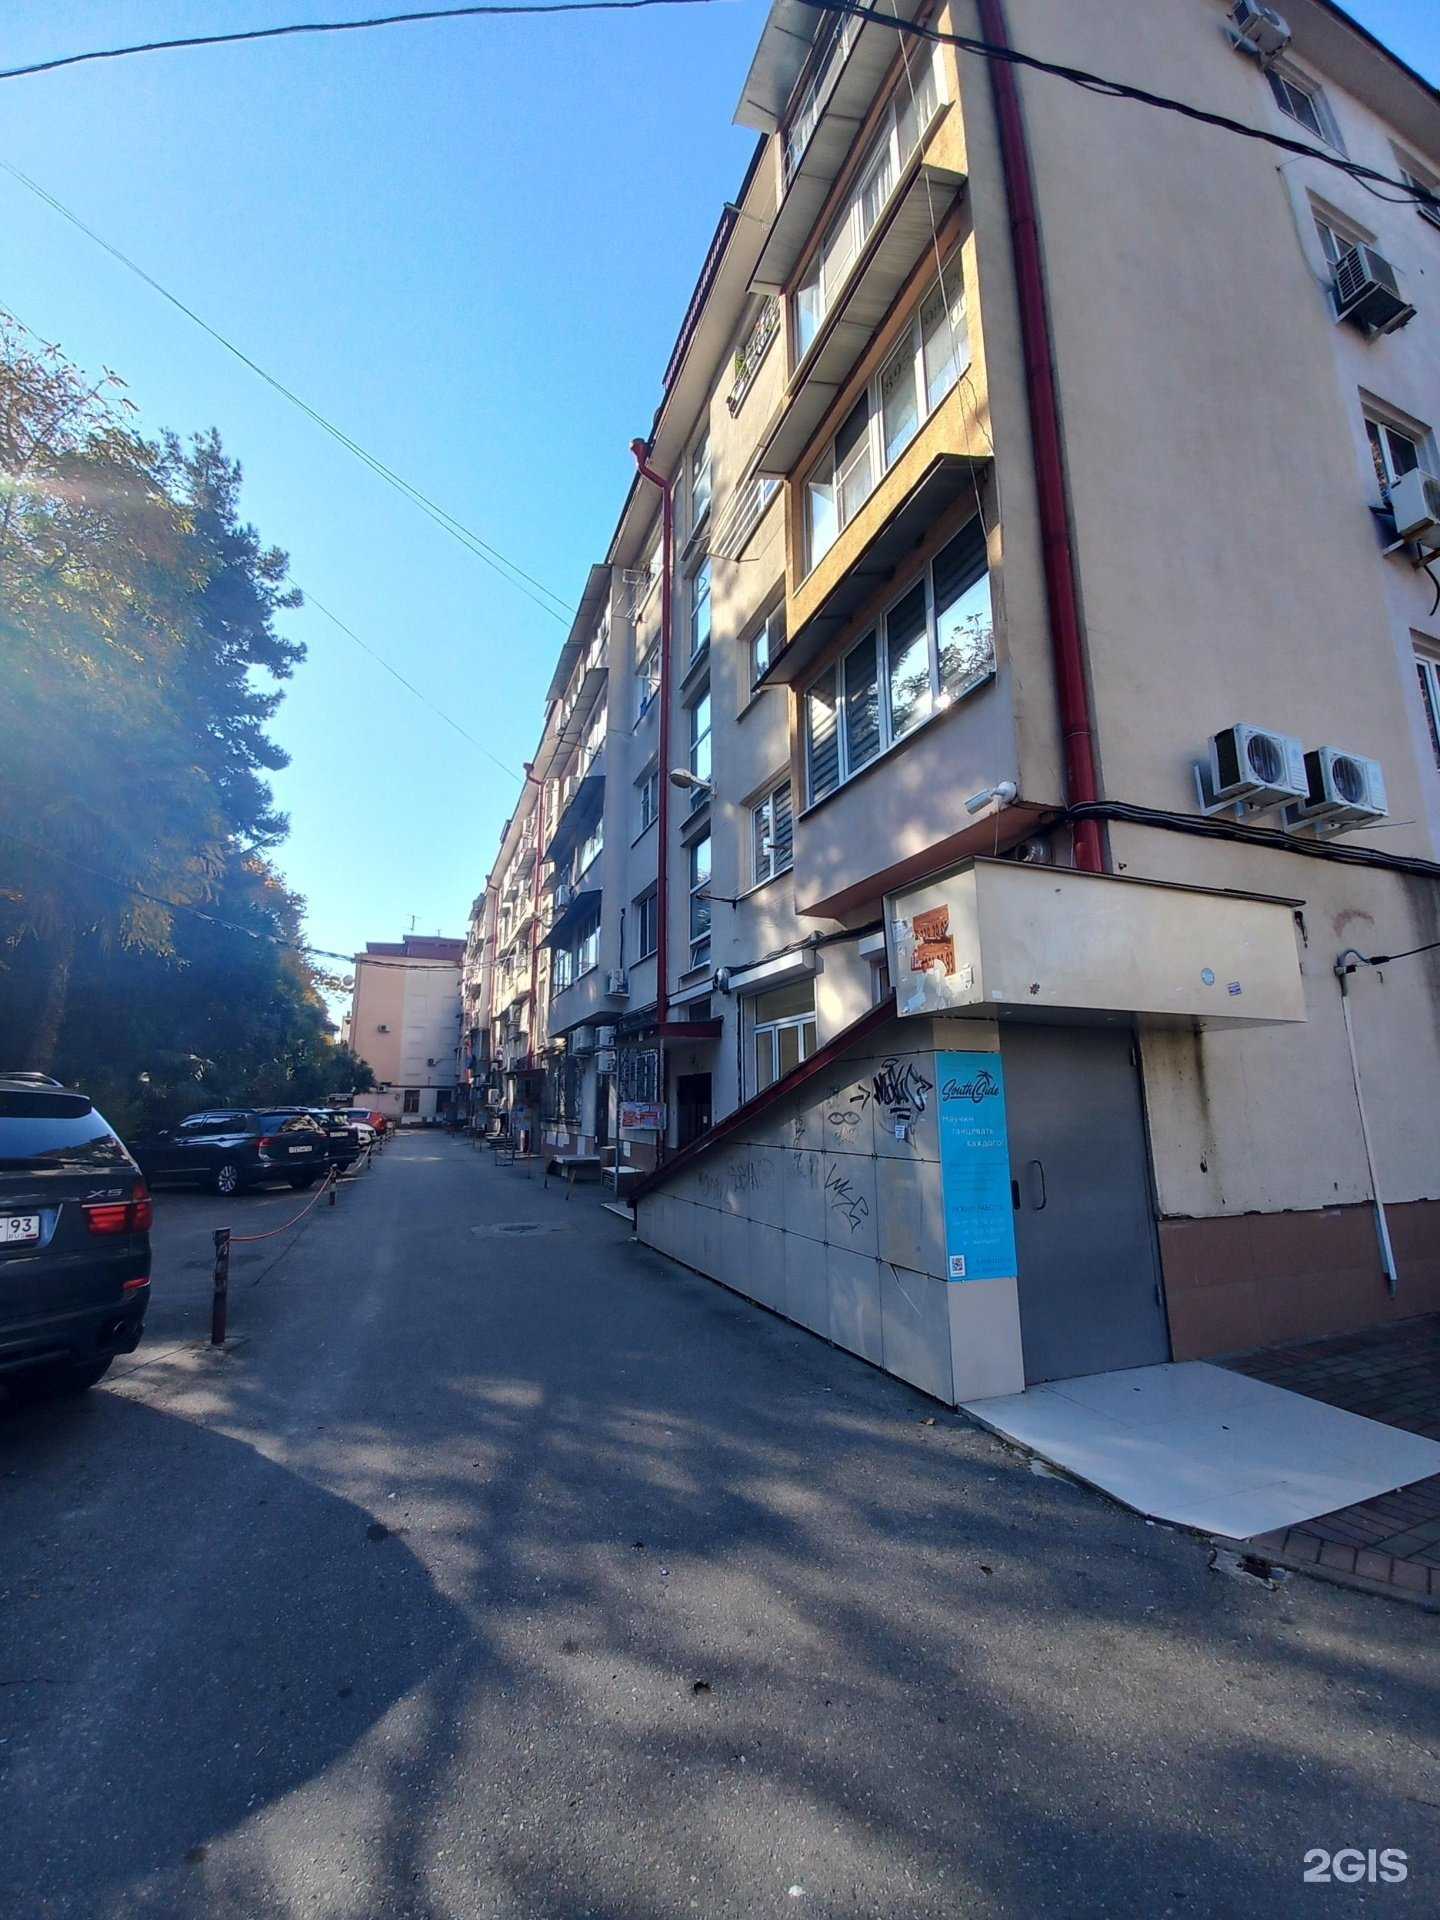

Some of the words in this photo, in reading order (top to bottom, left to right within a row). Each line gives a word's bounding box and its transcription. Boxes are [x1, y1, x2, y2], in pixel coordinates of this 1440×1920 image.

[942, 1079, 974, 1101] South
[971, 1079, 1000, 1103] Side
[87, 1189, 123, 1198] X5
[10, 1218, 32, 1233] 93
